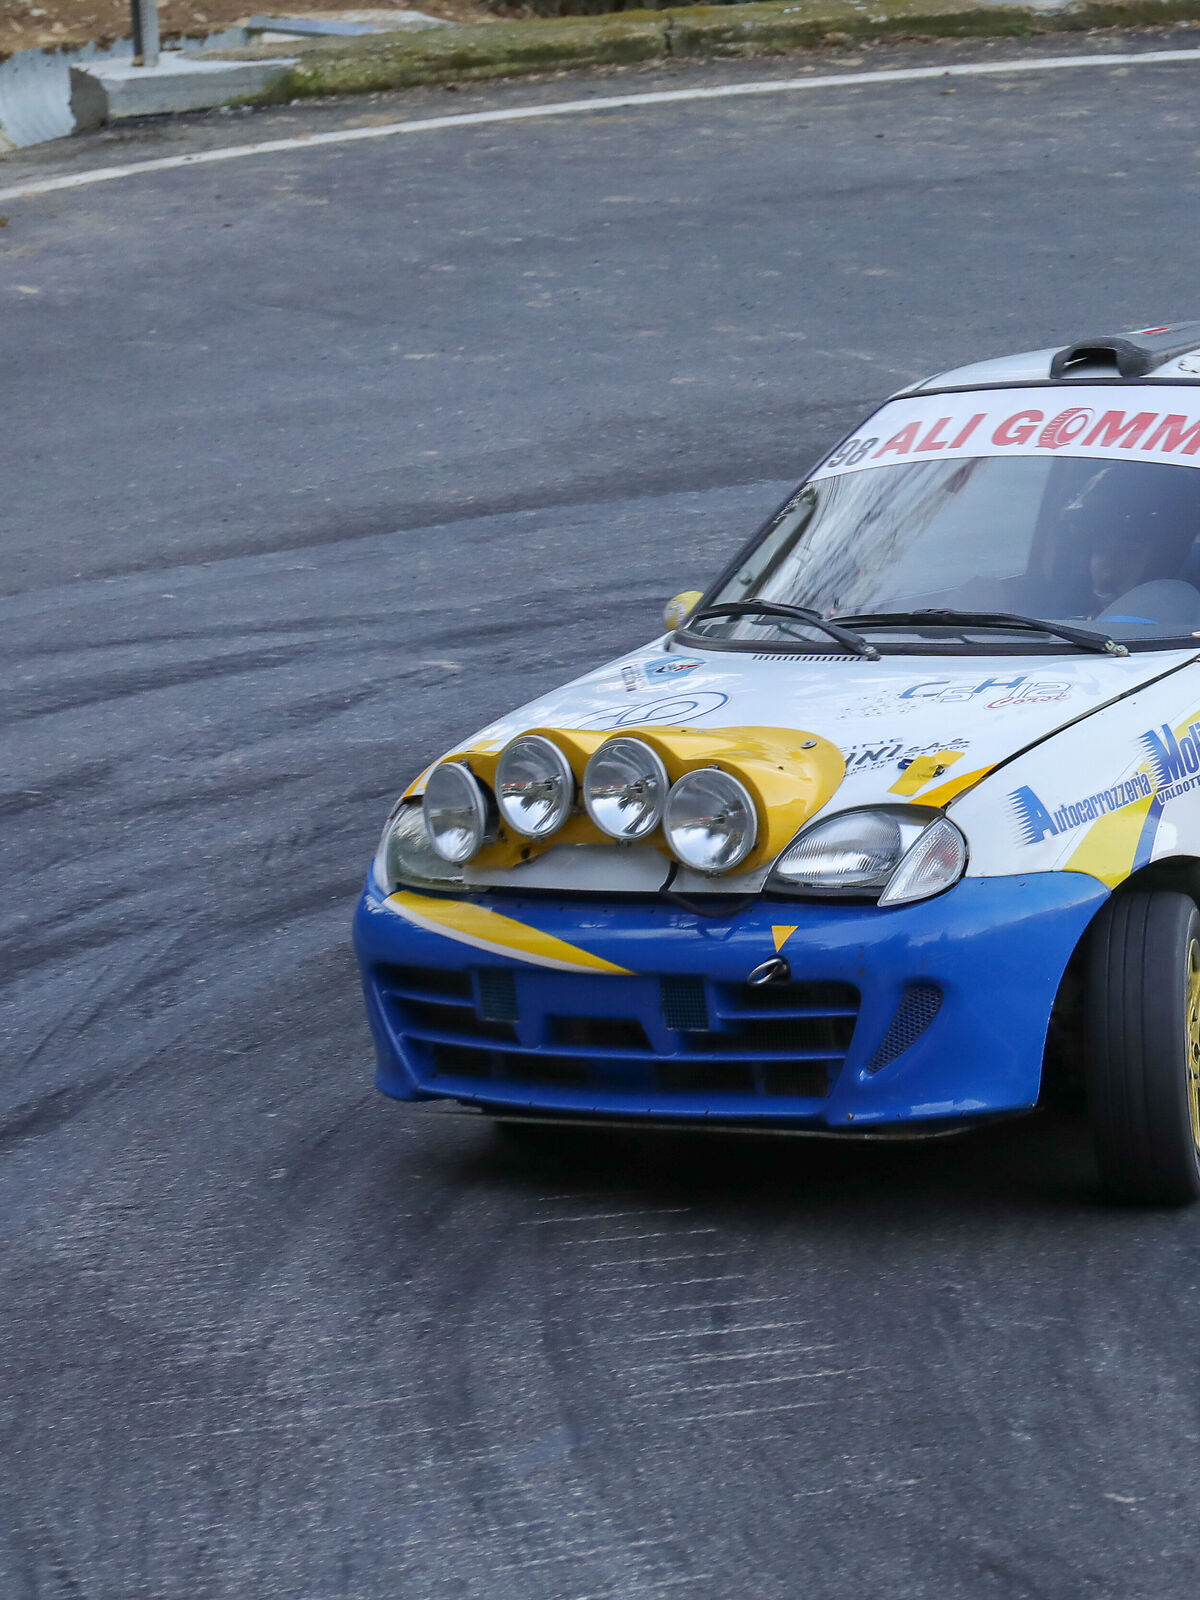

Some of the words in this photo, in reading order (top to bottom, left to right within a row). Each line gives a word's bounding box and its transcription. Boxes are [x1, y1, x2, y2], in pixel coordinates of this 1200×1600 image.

[827, 437, 879, 468] 98
[871, 413, 987, 459] ALI
[1006, 771, 1151, 845] Autocarrozzeria
